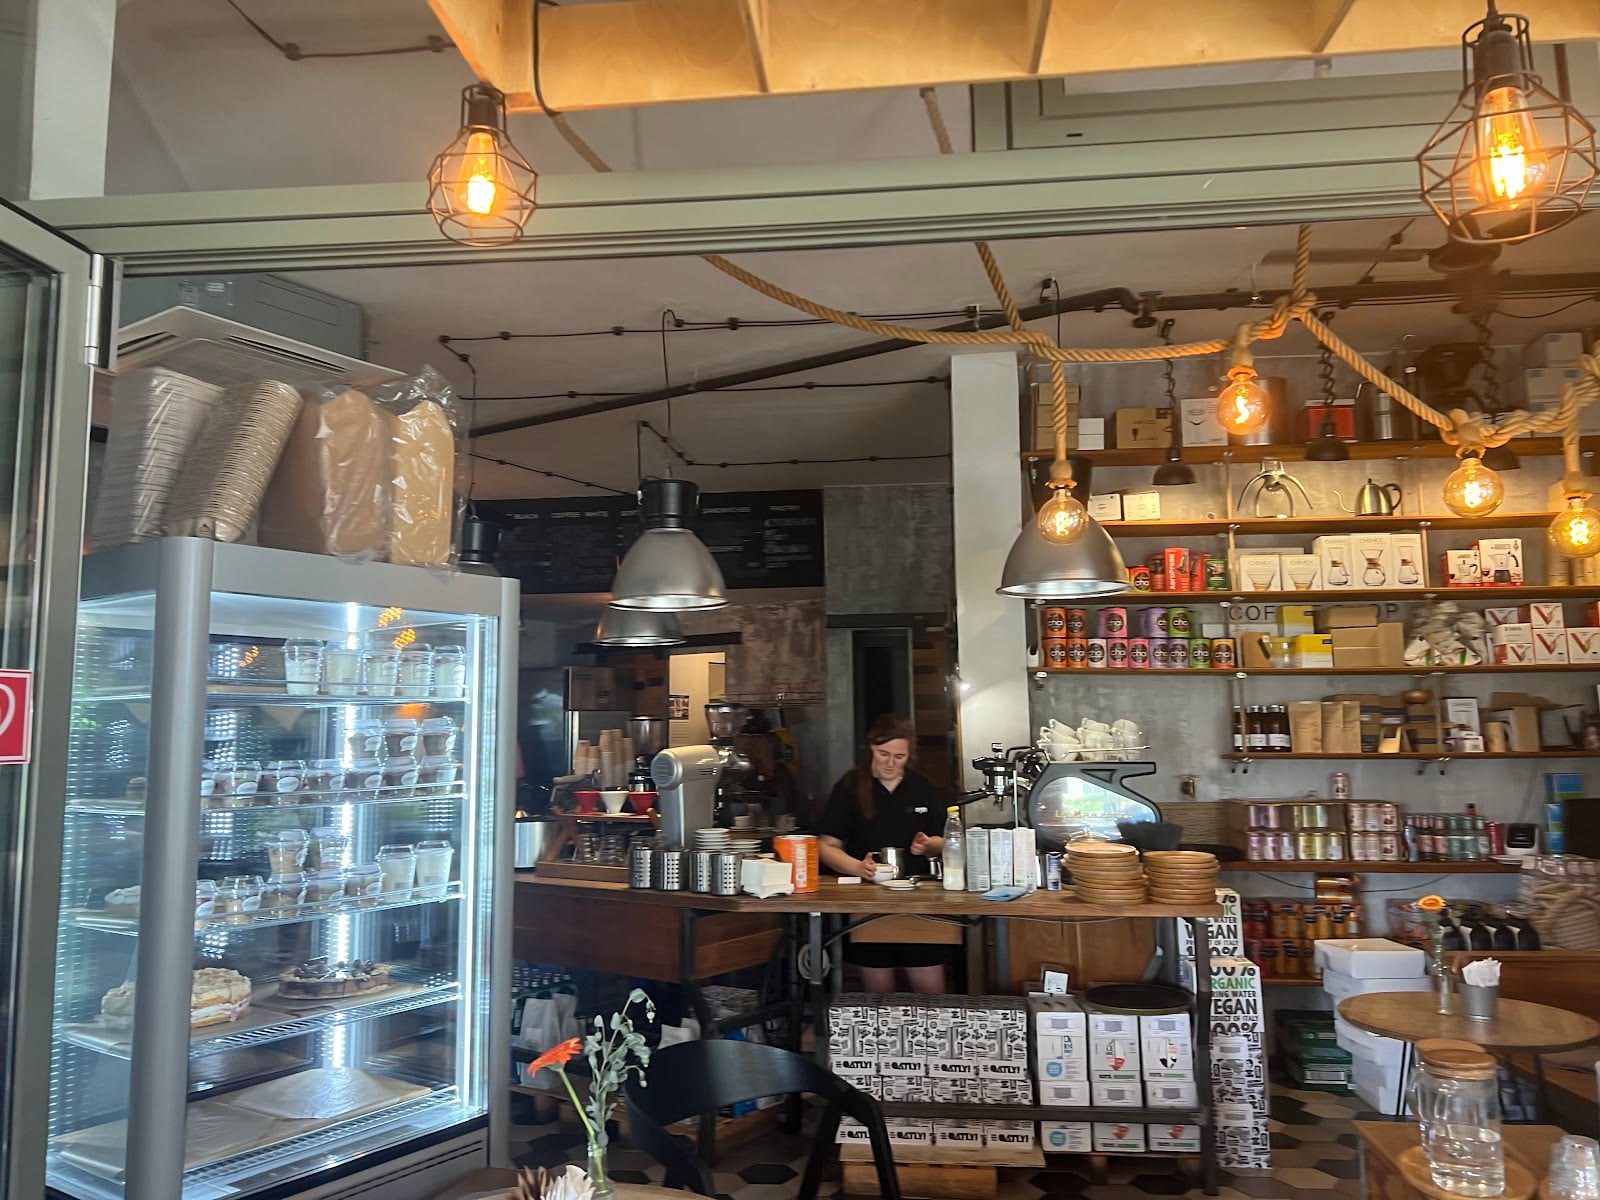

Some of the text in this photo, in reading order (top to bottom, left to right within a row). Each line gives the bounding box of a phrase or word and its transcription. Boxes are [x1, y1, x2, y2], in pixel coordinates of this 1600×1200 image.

[1229, 605, 1276, 620] COF
[1212, 977, 1256, 989] RGANIC
[1213, 998, 1258, 1015] EGAN
[847, 1131, 870, 1139] OATL
